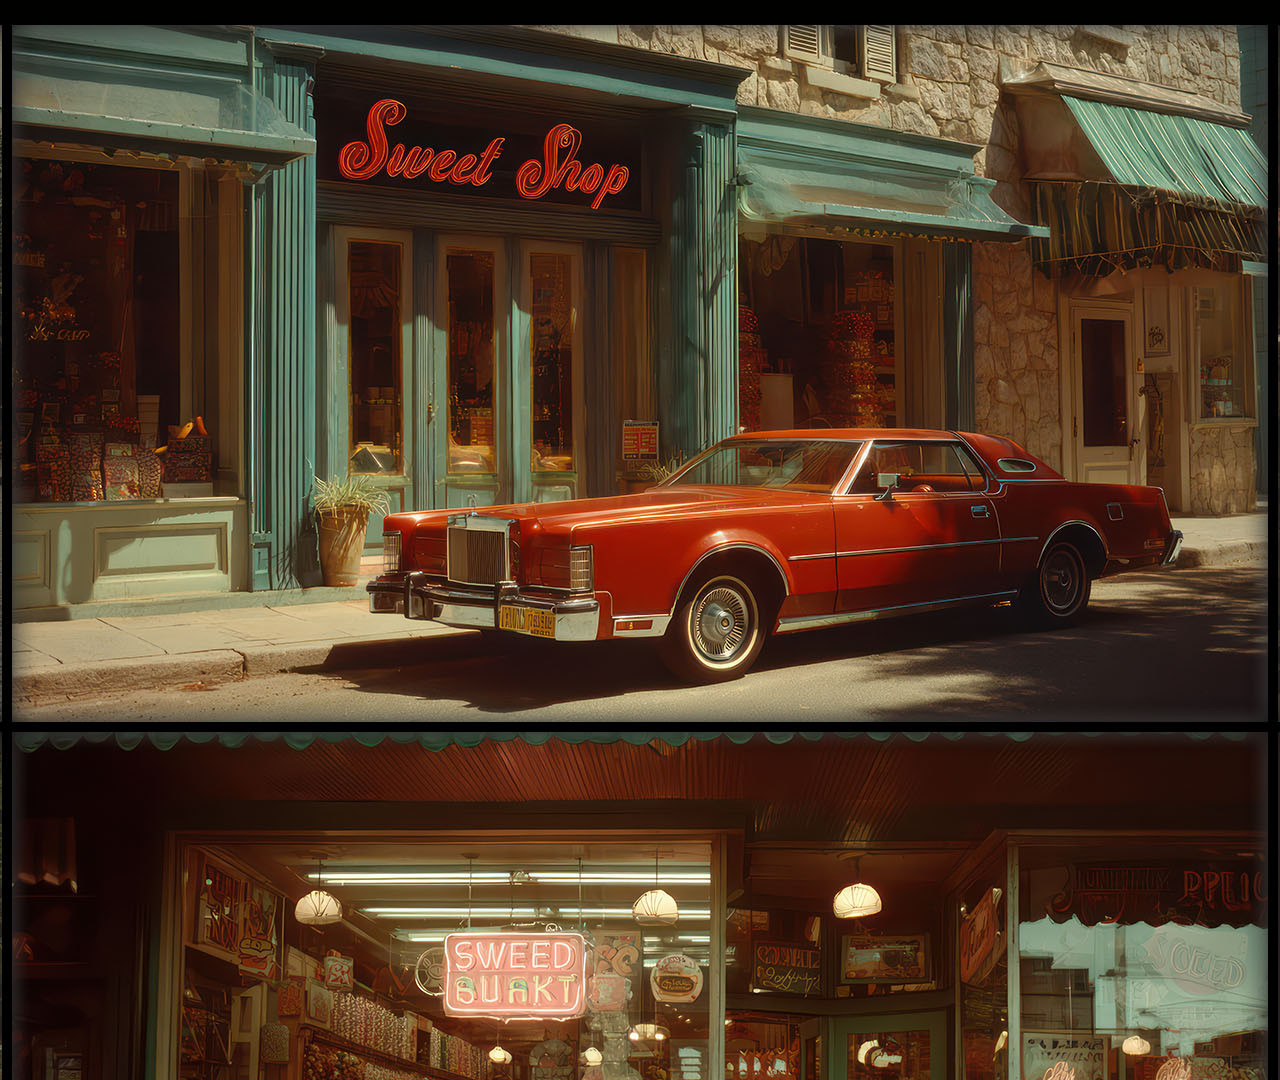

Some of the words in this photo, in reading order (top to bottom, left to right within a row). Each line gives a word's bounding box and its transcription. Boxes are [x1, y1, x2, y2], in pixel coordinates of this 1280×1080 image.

[338, 98, 506, 187] Sweet
[516, 123, 630, 210] Shop
[455, 941, 576, 970] SWEED
